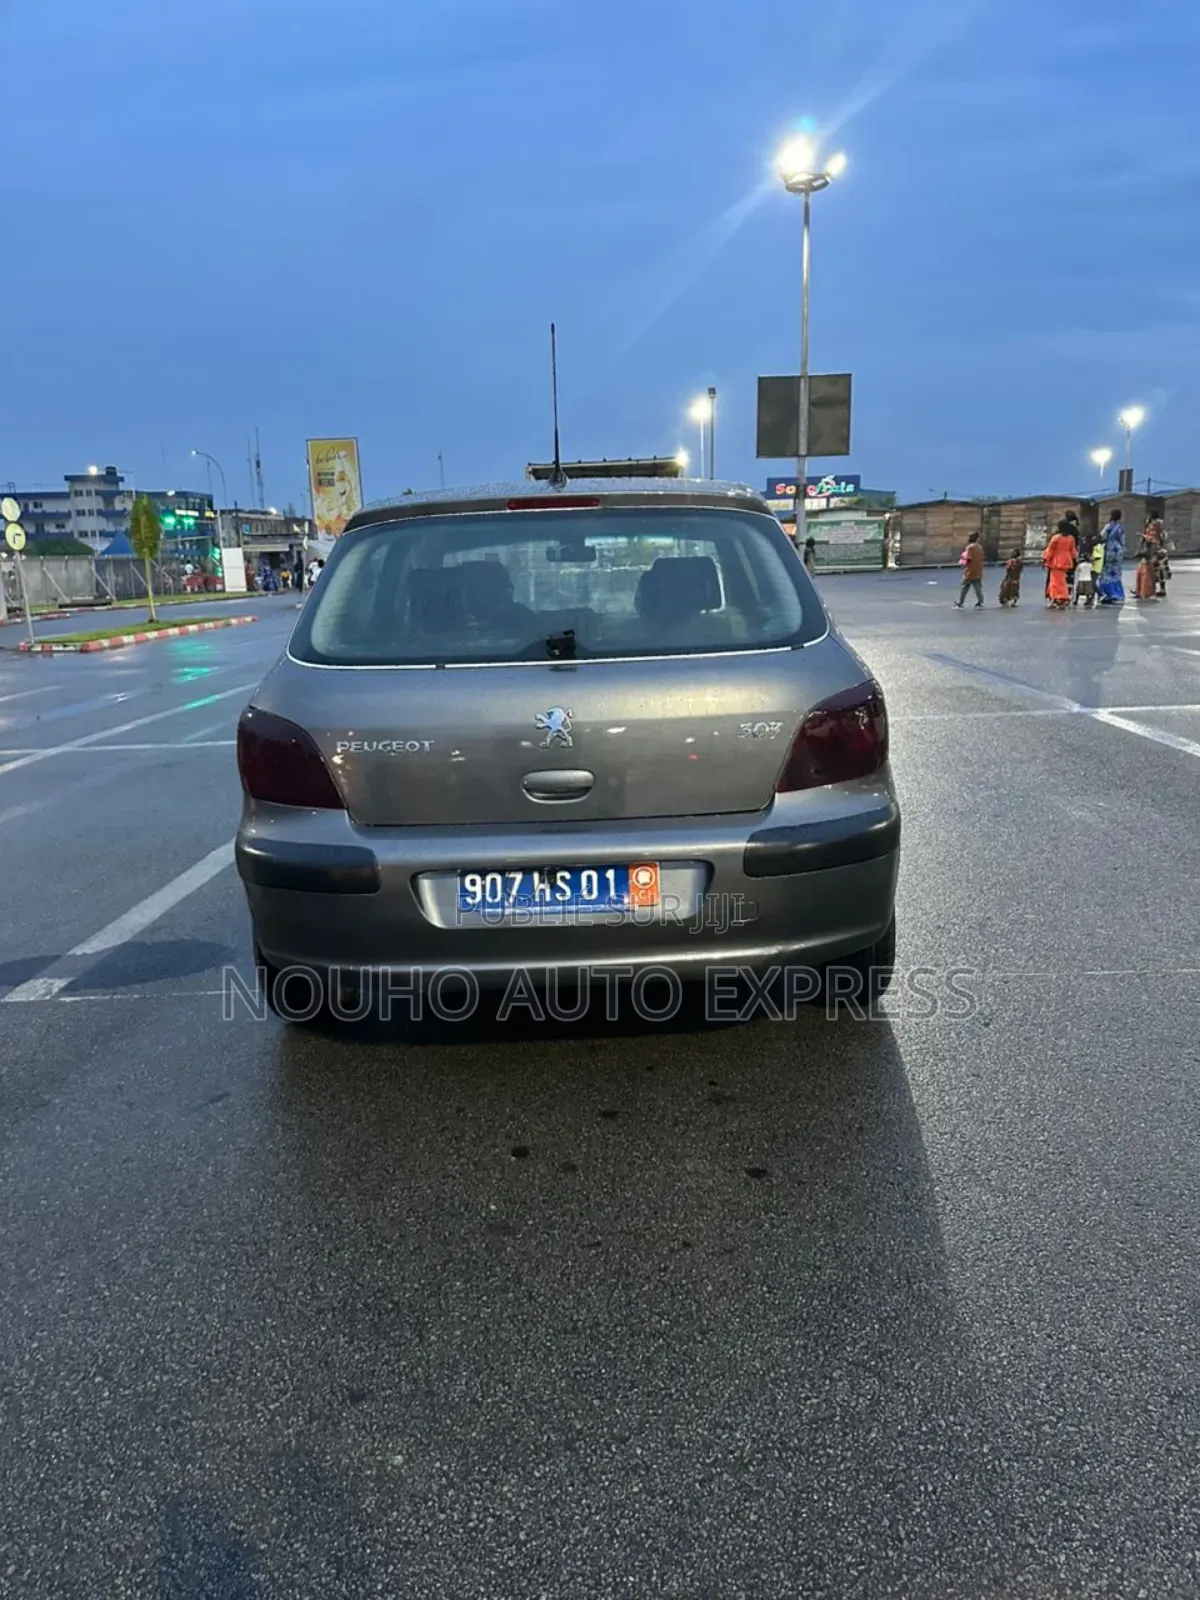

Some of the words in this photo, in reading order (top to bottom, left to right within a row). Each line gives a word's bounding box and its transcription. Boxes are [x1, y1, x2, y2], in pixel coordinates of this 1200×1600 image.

[736, 721, 784, 740] 307
[336, 739, 435, 752] PEUGEOT
[464, 871, 524, 904] 907
[533, 870, 572, 902] HS
[581, 869, 615, 900] 01
